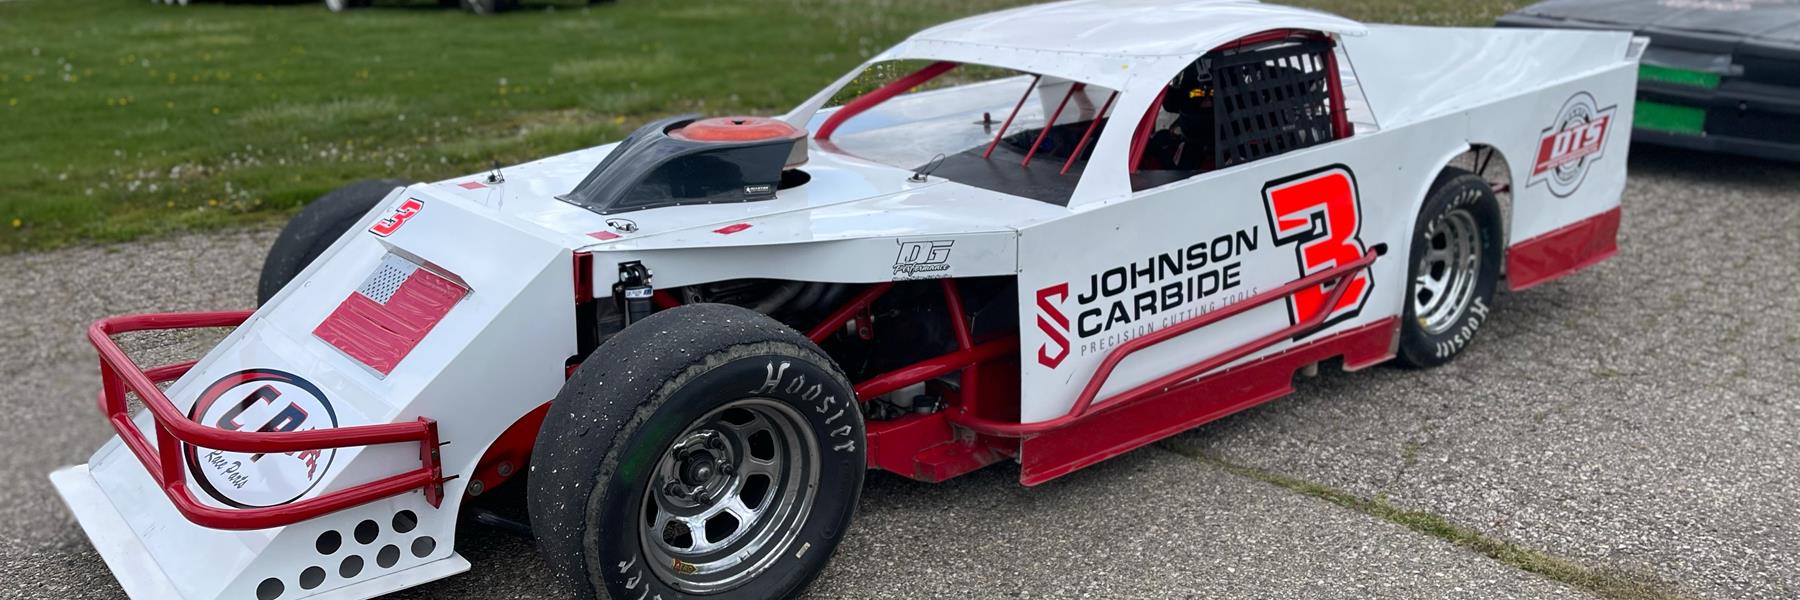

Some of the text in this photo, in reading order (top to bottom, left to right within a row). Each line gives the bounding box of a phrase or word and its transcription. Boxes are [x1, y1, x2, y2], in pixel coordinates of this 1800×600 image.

[1551, 118, 1605, 158] DTS
[368, 197, 424, 237] 3
[1261, 163, 1374, 342] 3
[1077, 226, 1258, 305] JOHNSON
[1077, 262, 1241, 338] CARBIDE
[1081, 287, 1258, 356] PRECISION CUTTING TOOLS
[748, 361, 856, 452] Hoosier
[205, 450, 248, 489] Race Parts
